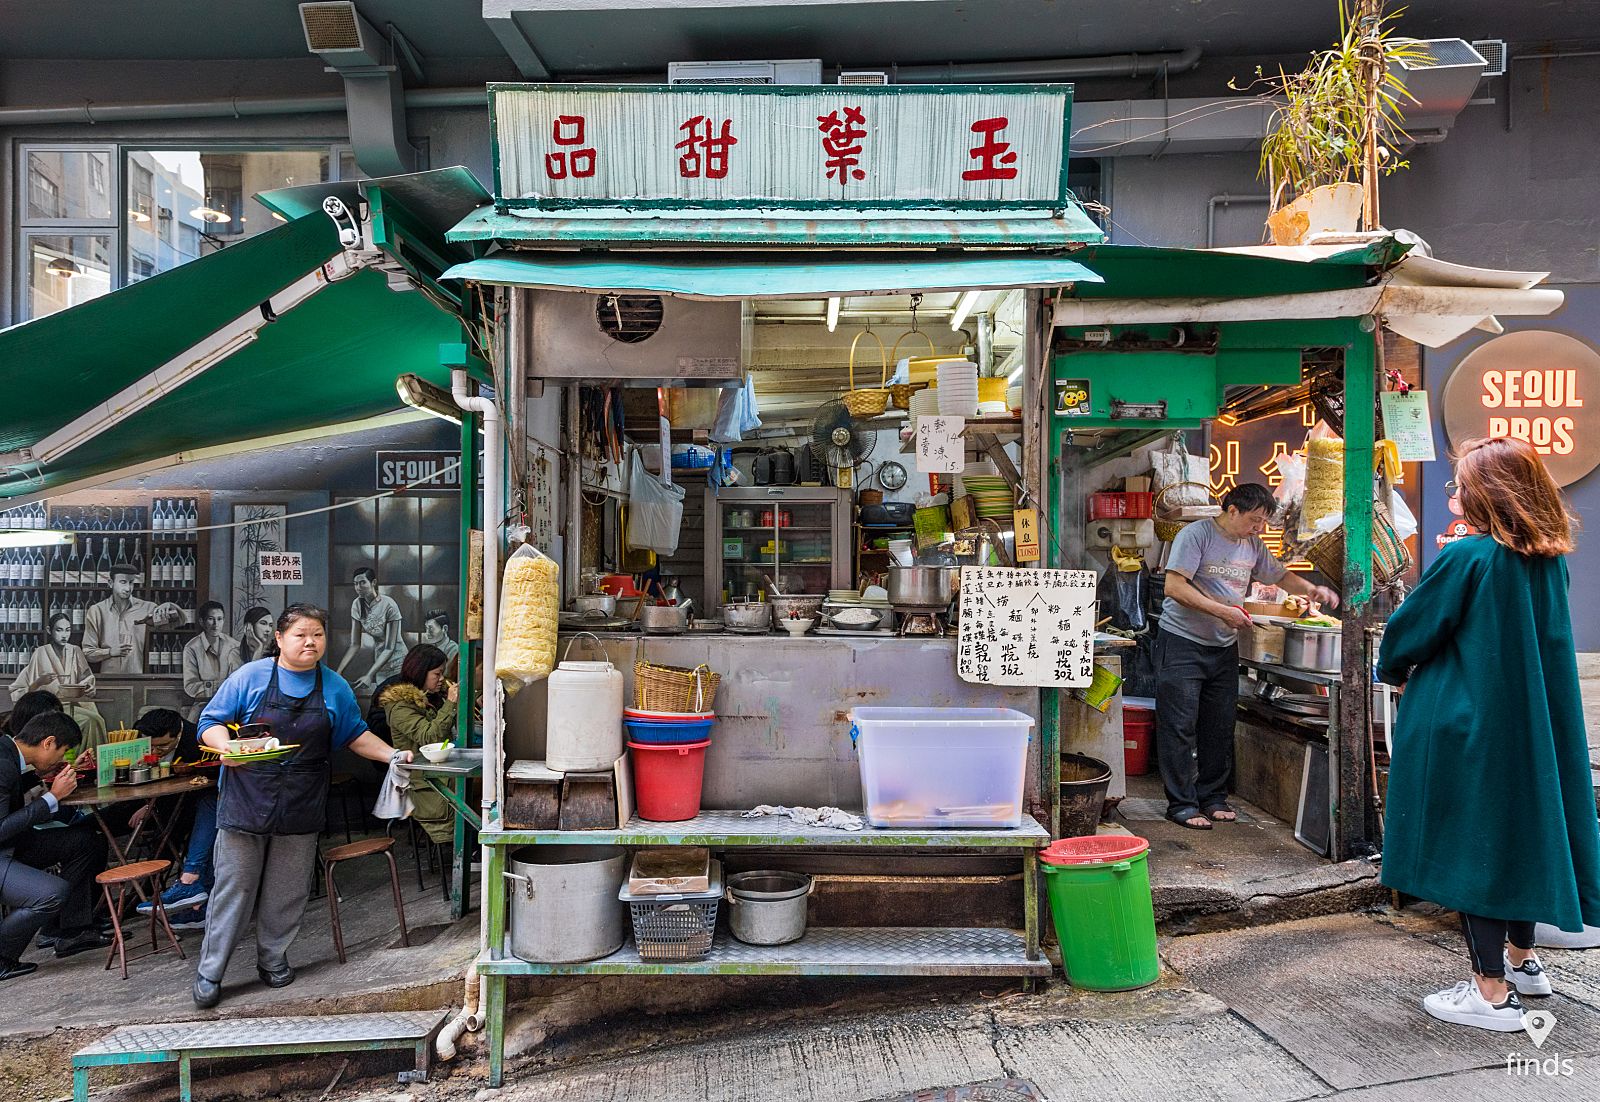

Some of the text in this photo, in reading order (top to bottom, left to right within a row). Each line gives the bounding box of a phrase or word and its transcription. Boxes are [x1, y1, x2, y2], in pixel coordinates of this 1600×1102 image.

[1482, 369, 1583, 408] SEOUL
[382, 460, 440, 485] SEOUL
[1021, 518, 1032, 543] 休息
[261, 555, 301, 566] 謝絕外來
[1018, 547, 1039, 557] CLOSED
[262, 569, 302, 580] 食物飲品
